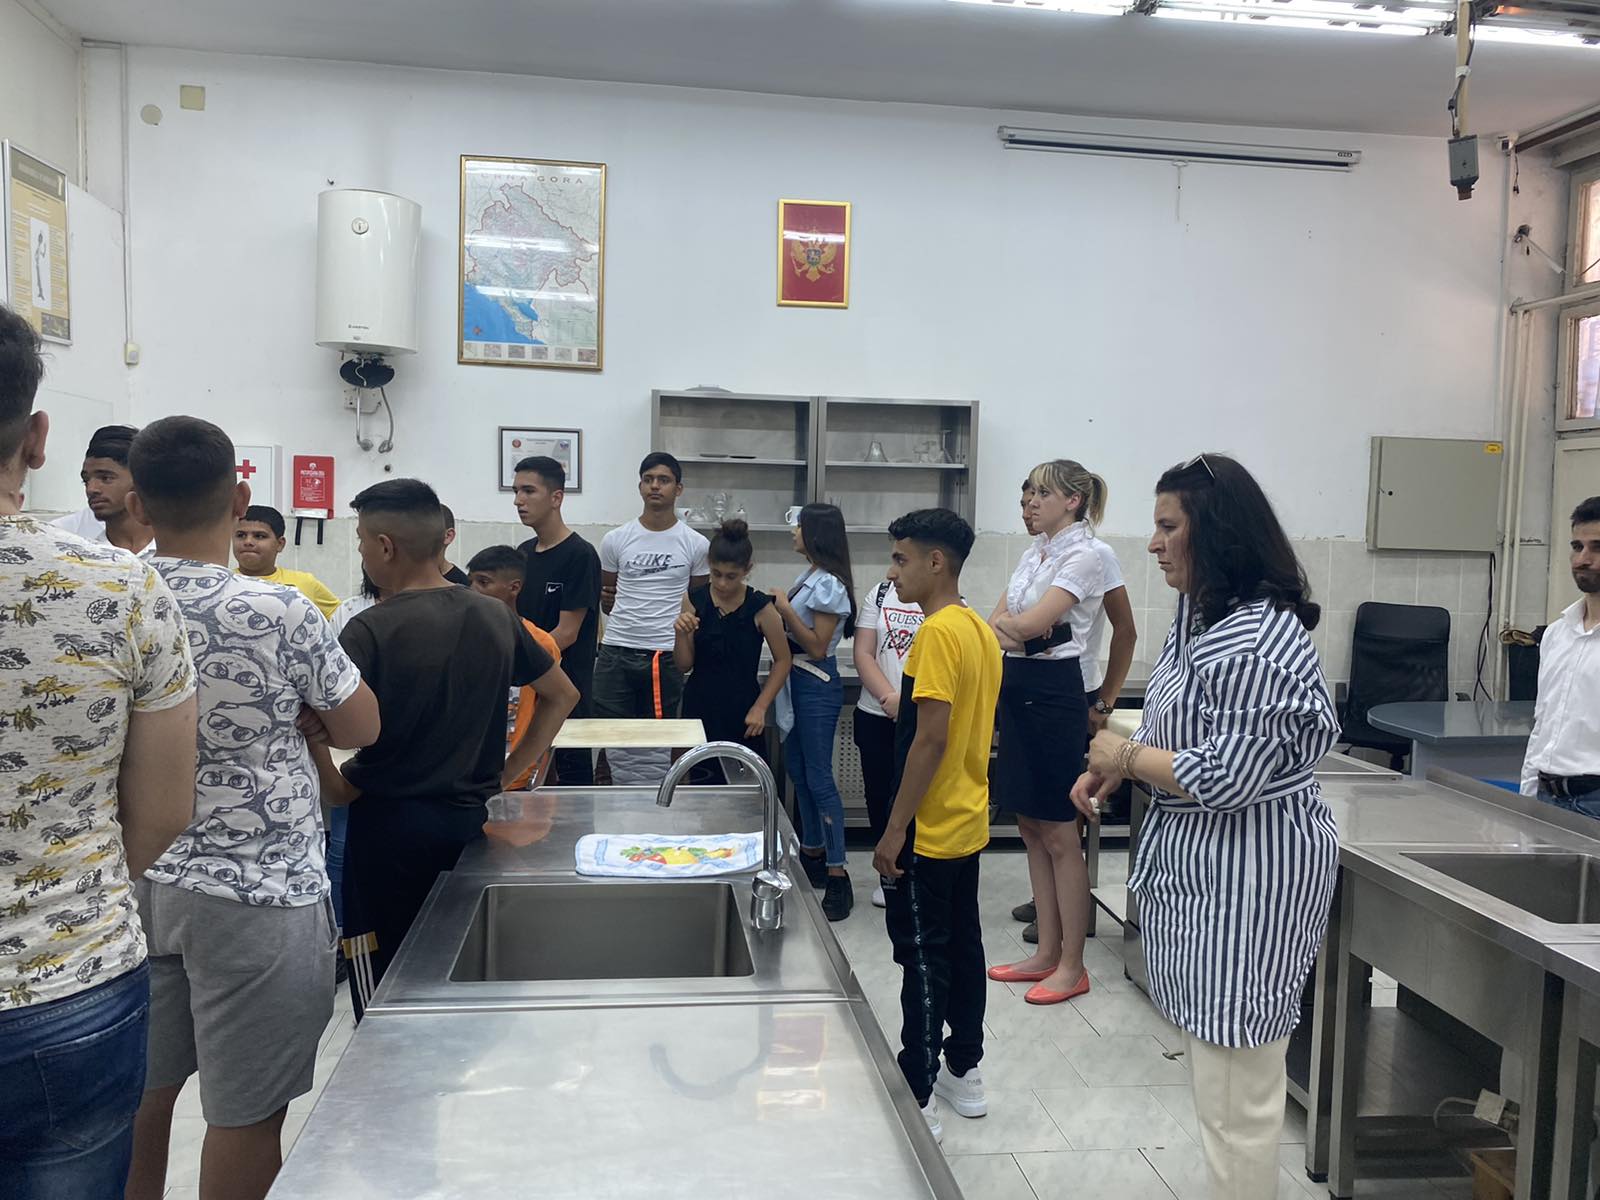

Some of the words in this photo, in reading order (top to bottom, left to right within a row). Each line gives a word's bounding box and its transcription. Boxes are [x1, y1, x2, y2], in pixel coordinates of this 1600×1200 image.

[537, 175, 584, 184] GORA
[632, 553, 673, 567] NIKE
[888, 612, 925, 626] GUESS
